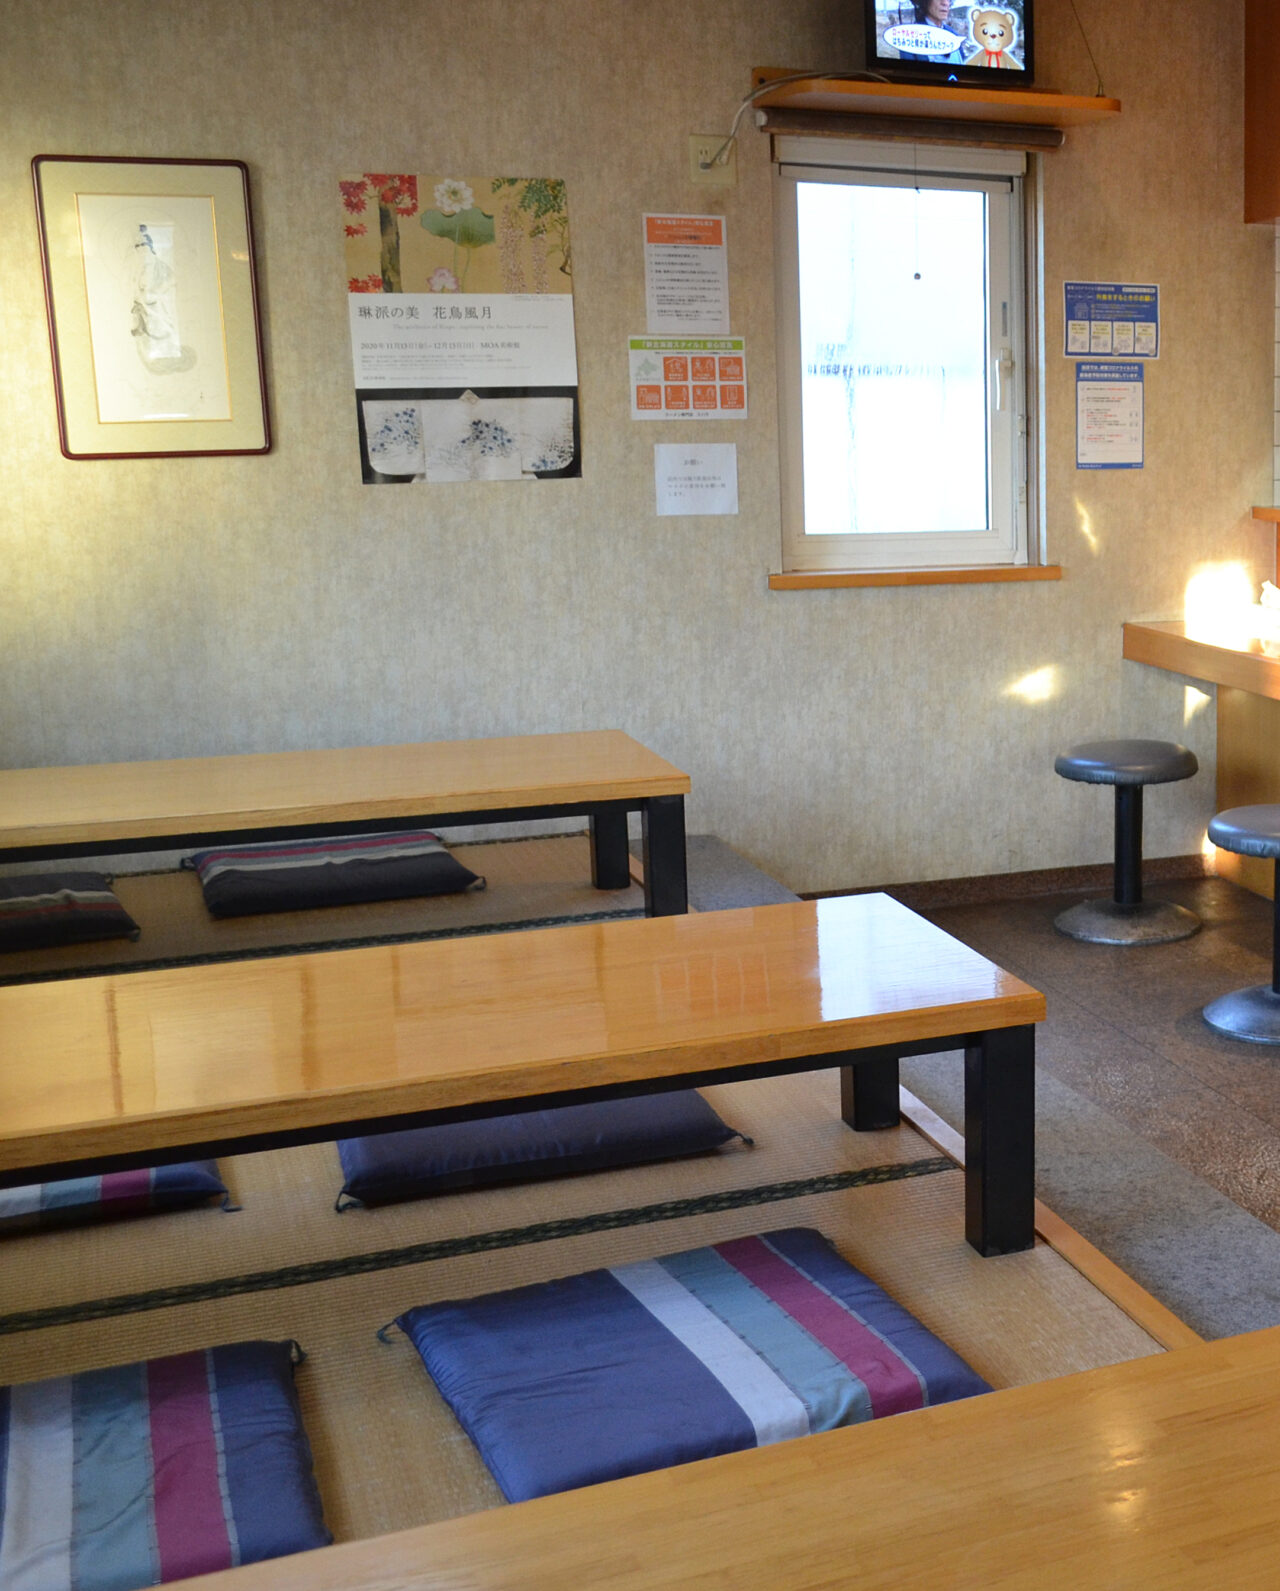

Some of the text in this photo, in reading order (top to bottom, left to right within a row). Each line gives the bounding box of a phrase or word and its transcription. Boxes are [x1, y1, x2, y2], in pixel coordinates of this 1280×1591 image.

[358, 305, 492, 320] 琳派の美 花鳥風月
